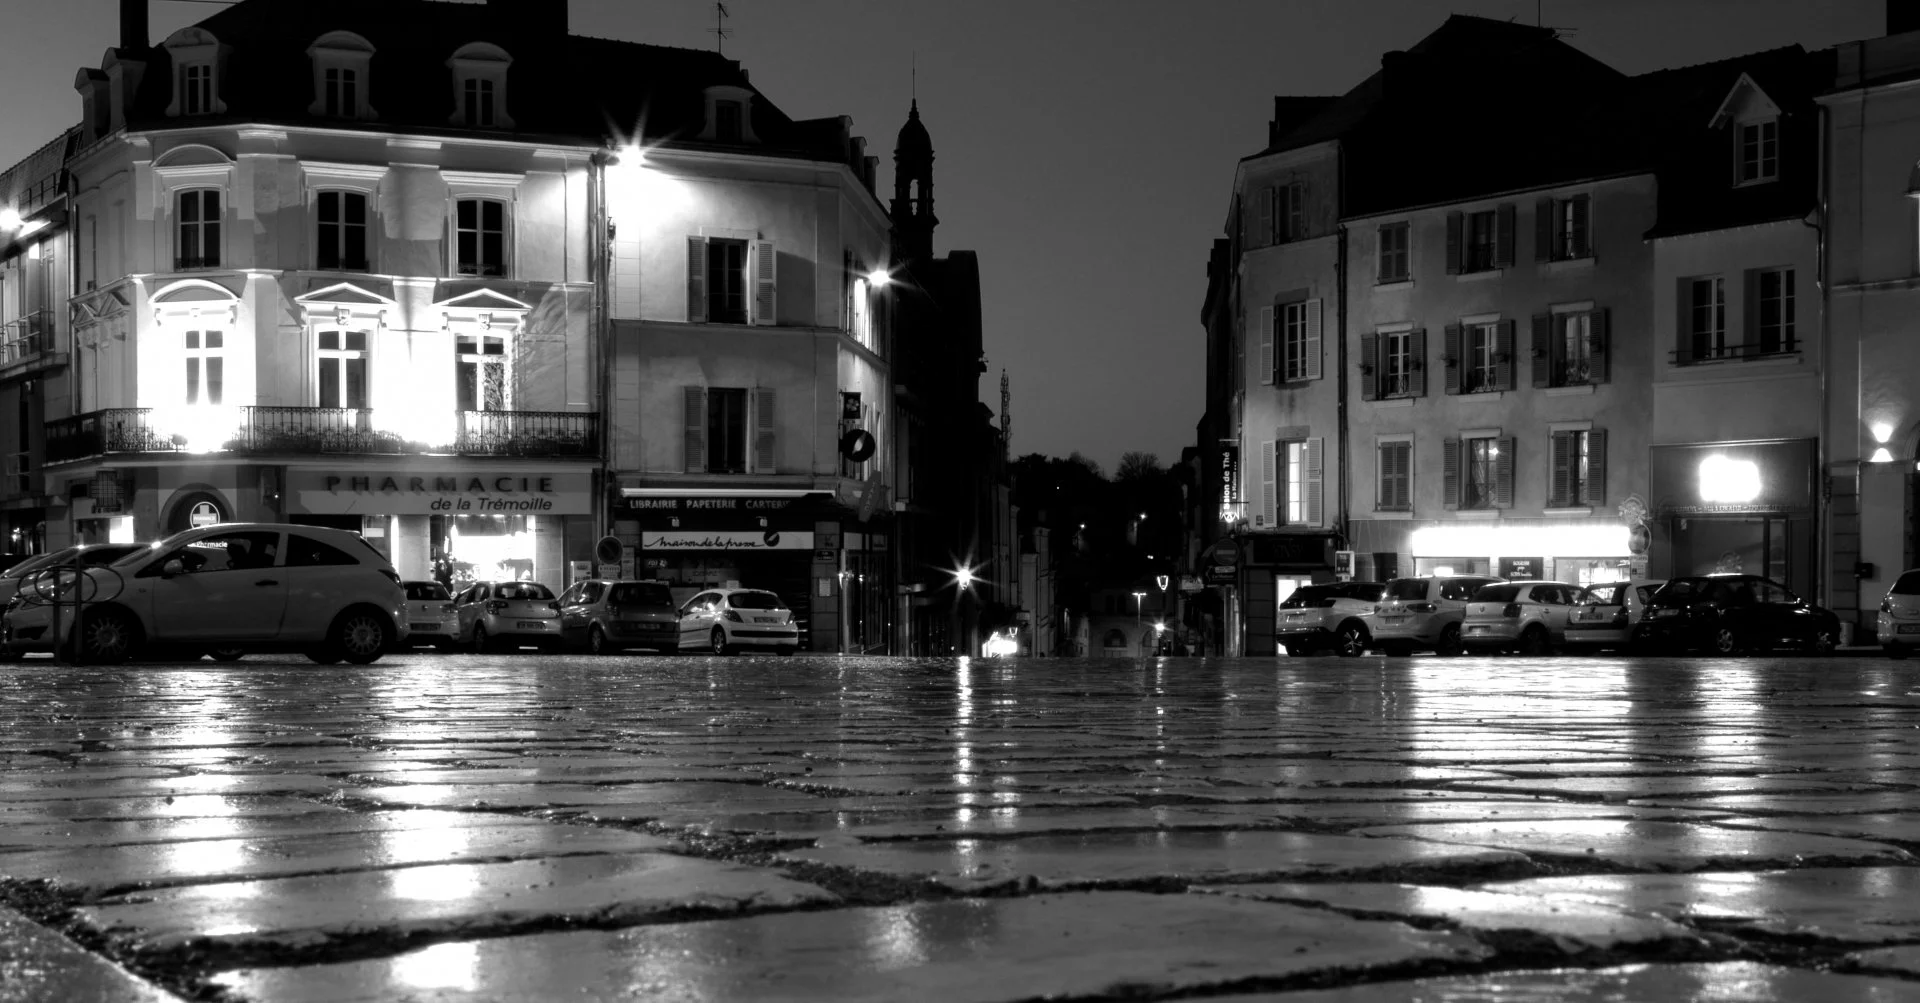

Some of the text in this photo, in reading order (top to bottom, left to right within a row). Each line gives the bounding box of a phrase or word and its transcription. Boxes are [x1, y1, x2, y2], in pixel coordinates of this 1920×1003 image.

[1222, 452, 1230, 469] Thé
[1223, 471, 1230, 482] de
[327, 477, 553, 492] PHARMACIE
[430, 498, 553, 510] de la Trémoille
[630, 499, 678, 509] LIBRAIRIE
[686, 499, 737, 509] PAPETERIE
